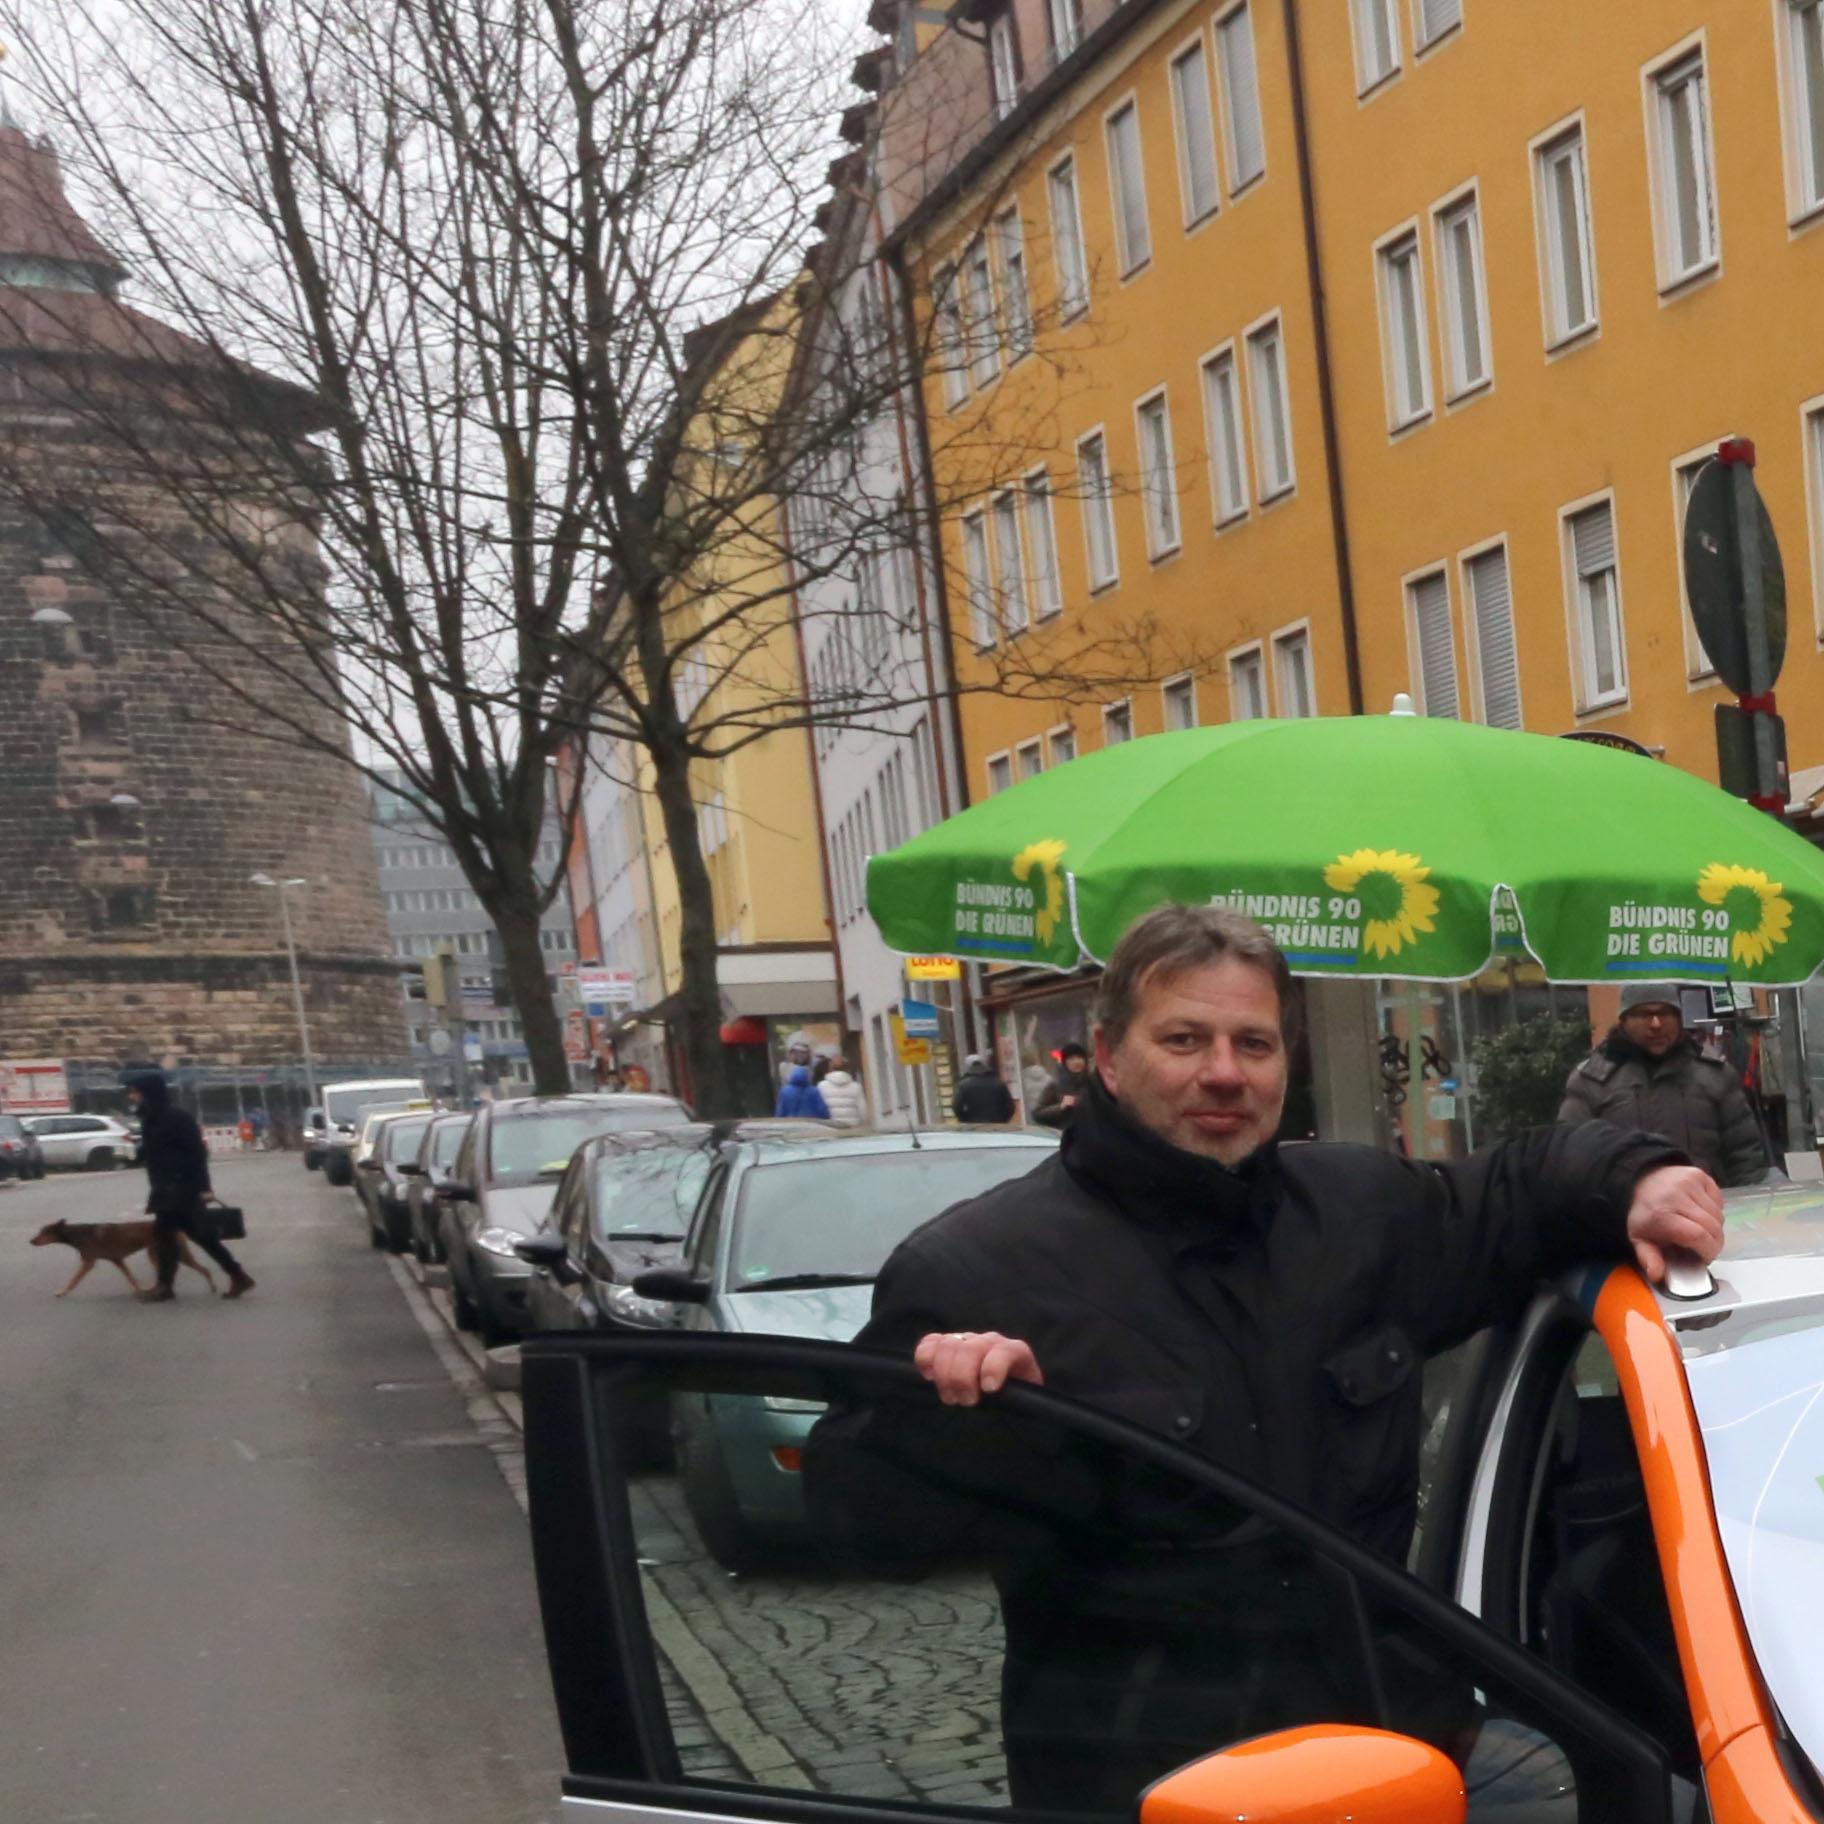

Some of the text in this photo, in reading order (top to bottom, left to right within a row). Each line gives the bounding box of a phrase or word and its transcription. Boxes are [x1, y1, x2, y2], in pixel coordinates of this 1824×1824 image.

[956, 877, 1035, 909] BÜNDNIS 90
[955, 908, 1036, 937] DIE GRÜNEN
[1328, 897, 1362, 920] 90
[1609, 900, 1730, 932] BÜNDNIS 90
[1606, 929, 1730, 959] DIE GRÜNEN
